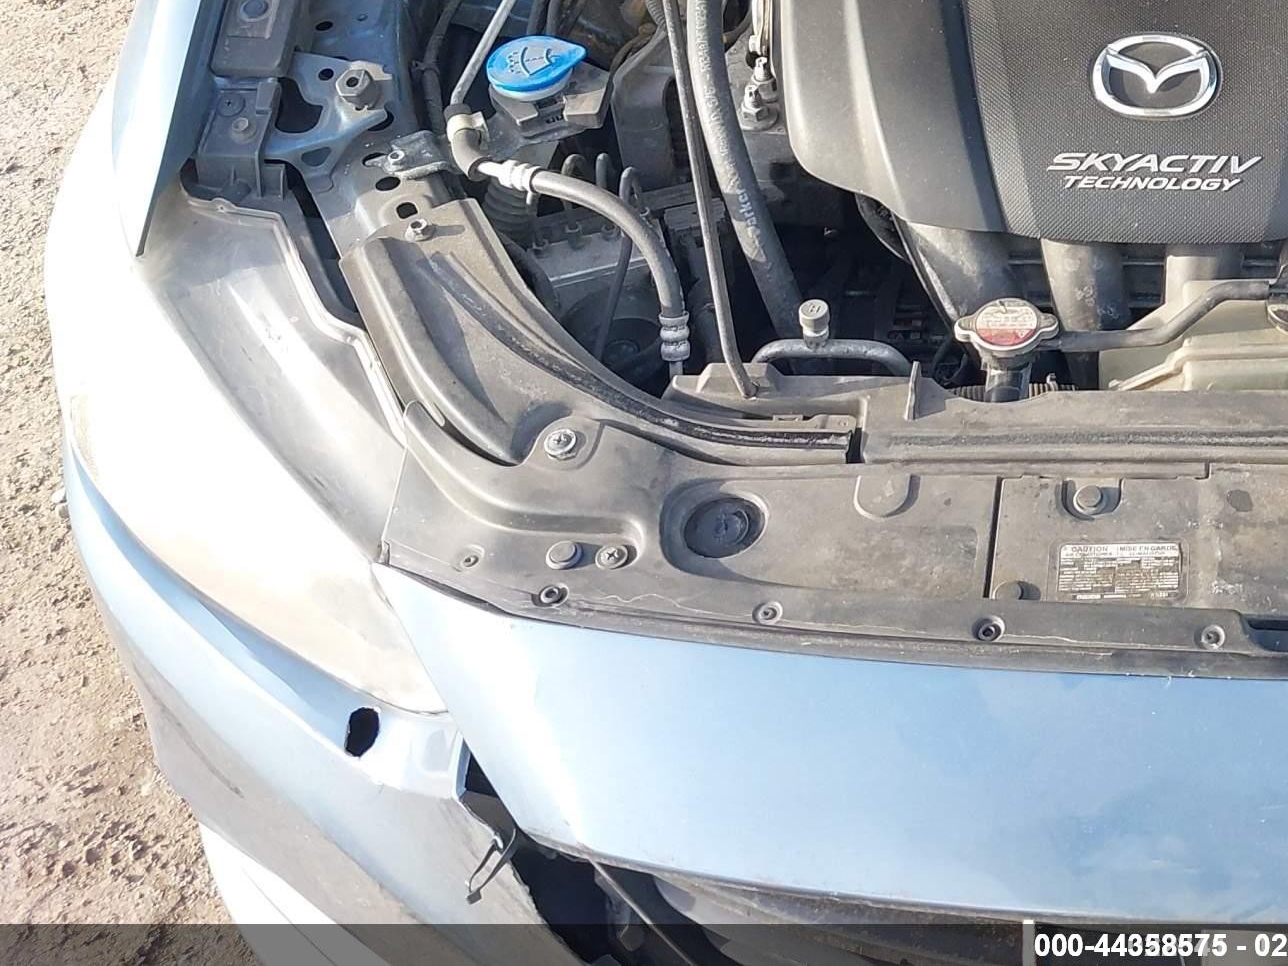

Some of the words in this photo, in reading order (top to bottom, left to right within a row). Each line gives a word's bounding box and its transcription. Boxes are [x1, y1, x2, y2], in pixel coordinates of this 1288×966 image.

[1046, 152, 1263, 174] SKYACTIV
[1063, 175, 1243, 192] TECHNOLOGY
[1071, 545, 1109, 553] CAUTION
